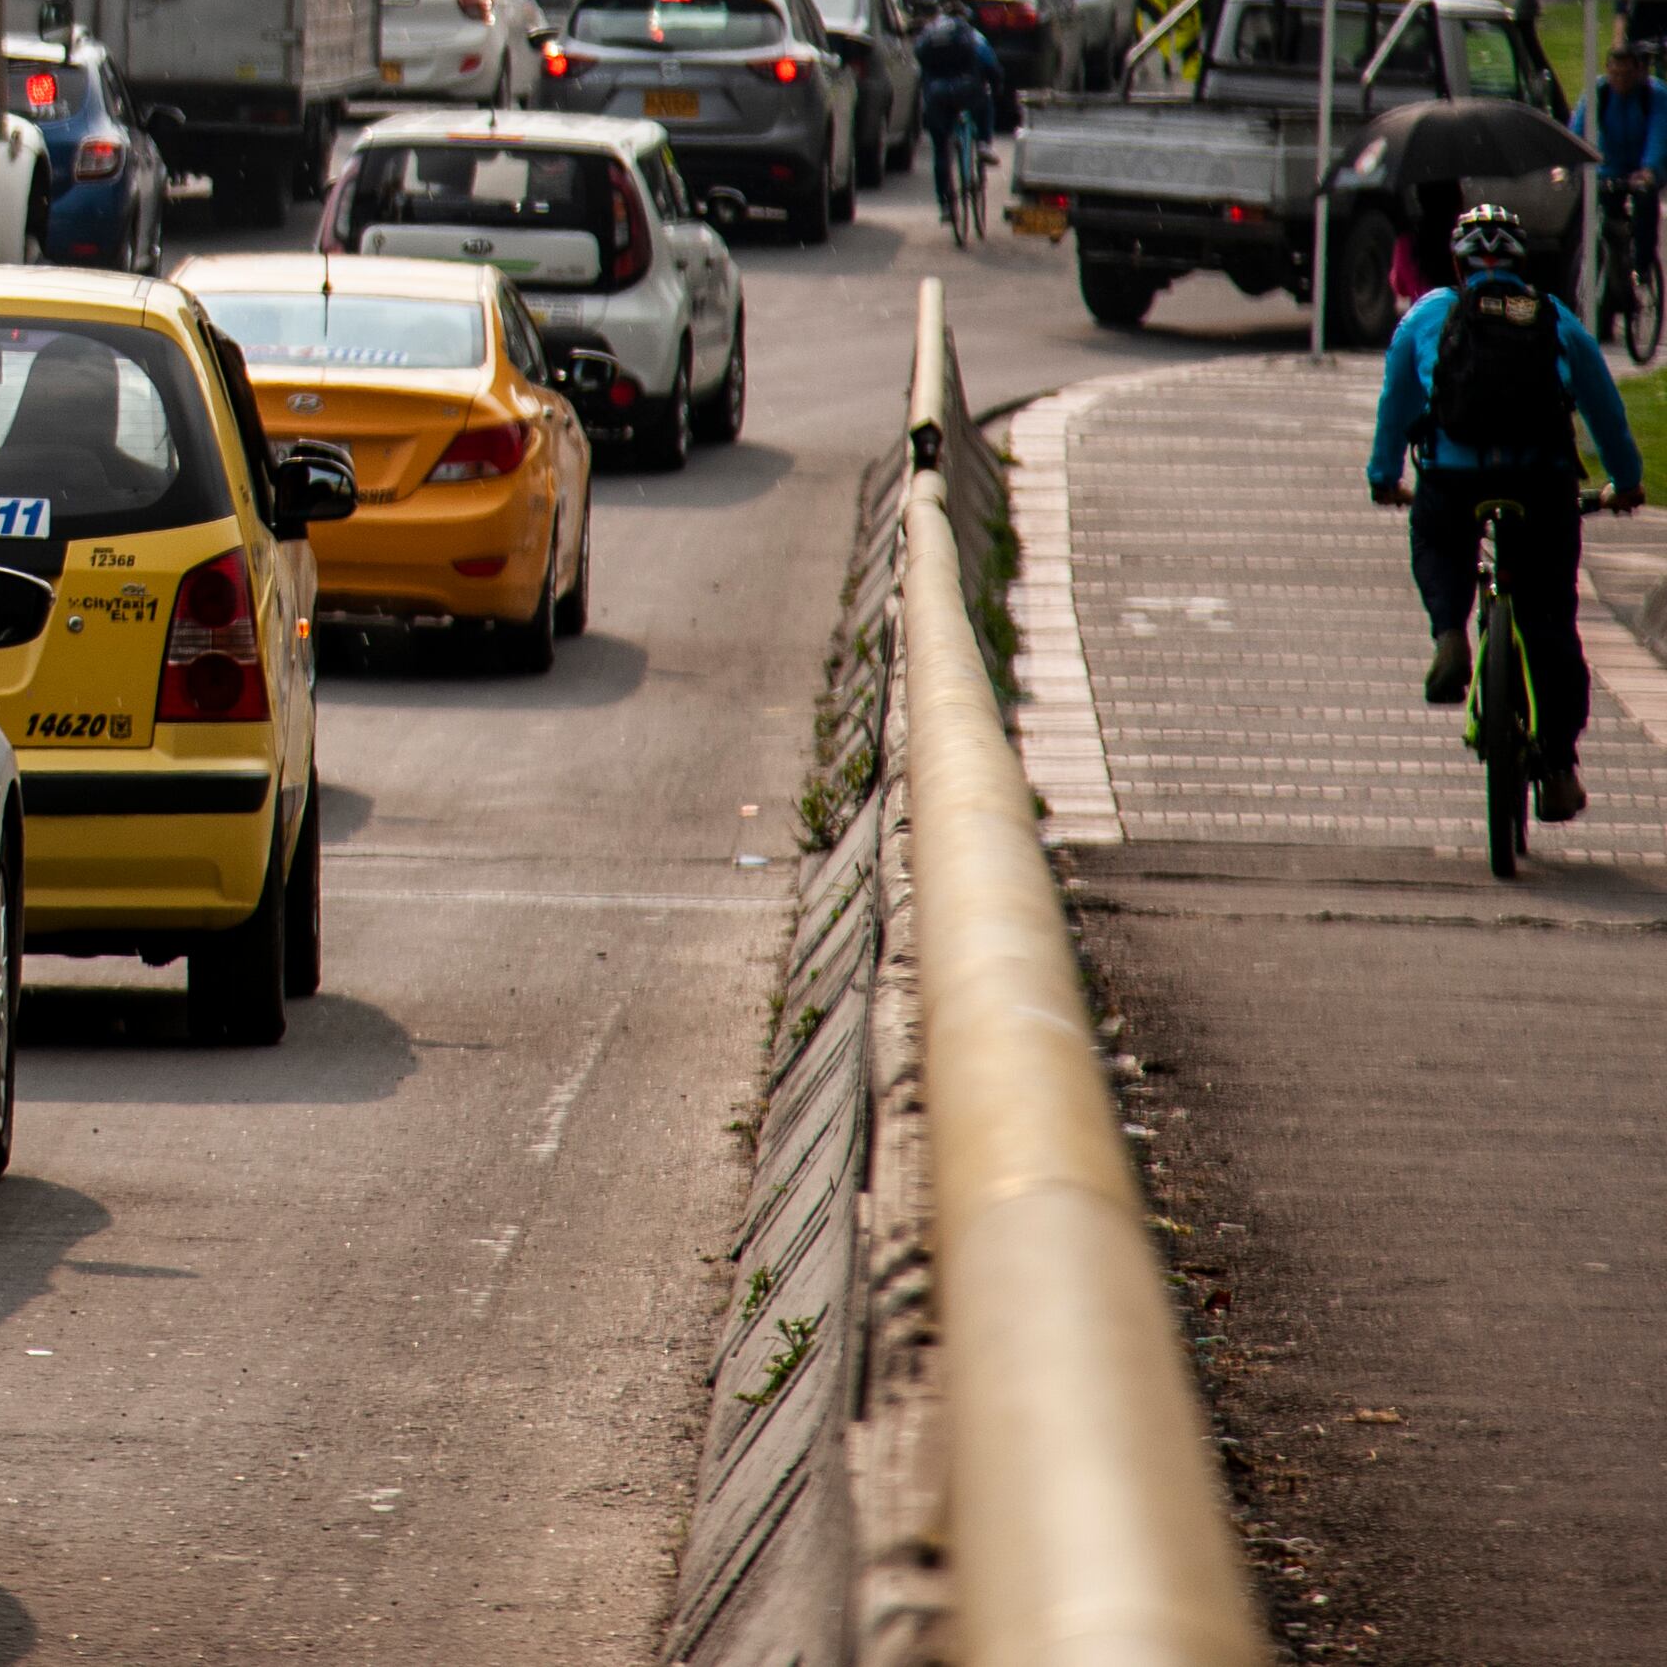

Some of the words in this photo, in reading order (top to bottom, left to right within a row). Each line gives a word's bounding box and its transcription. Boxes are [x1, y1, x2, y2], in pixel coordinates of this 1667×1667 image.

[91, 554, 136, 567] 12368
[83, 597, 144, 611] CityTaxi
[111, 610, 129, 622] EL
[25, 713, 109, 738] 14620
